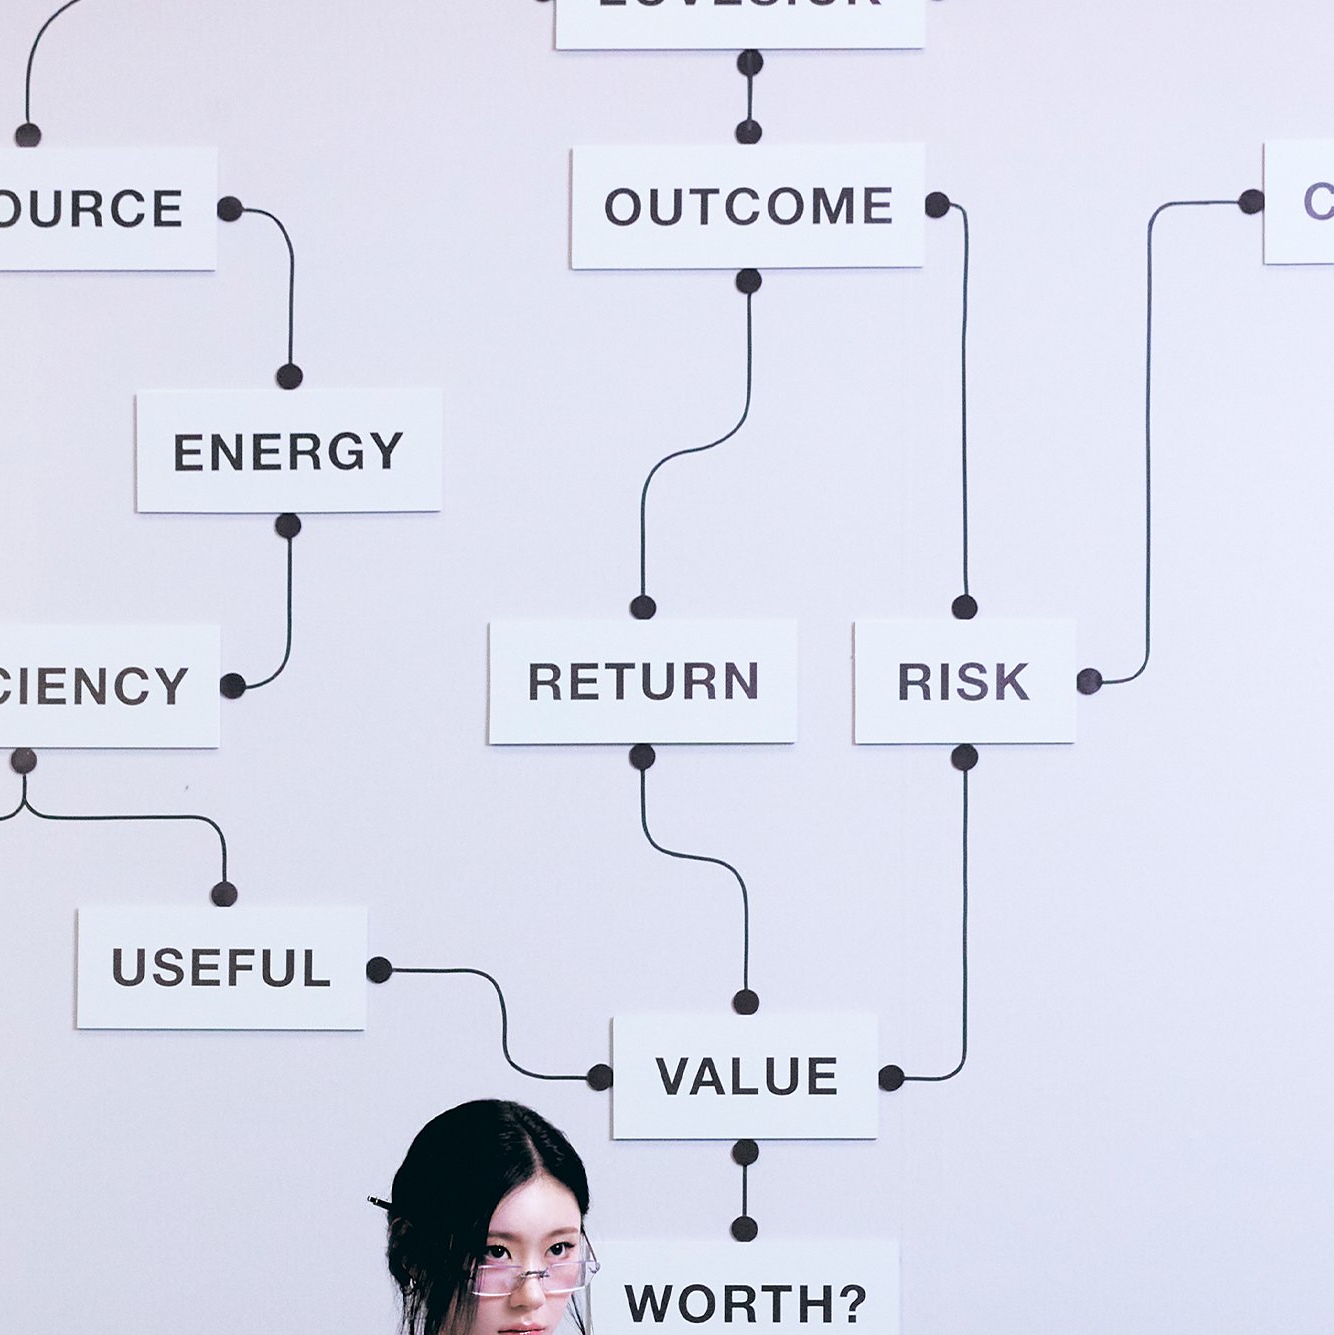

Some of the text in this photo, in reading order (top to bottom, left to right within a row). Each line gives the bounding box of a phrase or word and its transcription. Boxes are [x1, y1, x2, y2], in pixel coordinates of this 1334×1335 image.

[605, 187, 892, 226] OUTCOME
[175, 432, 403, 471] ENERGY
[530, 663, 757, 700] RETURN
[900, 663, 1029, 701] RISK
[113, 948, 330, 987] USEFUL
[656, 1058, 837, 1095] VALUE
[625, 1284, 865, 1323] WORTH?
